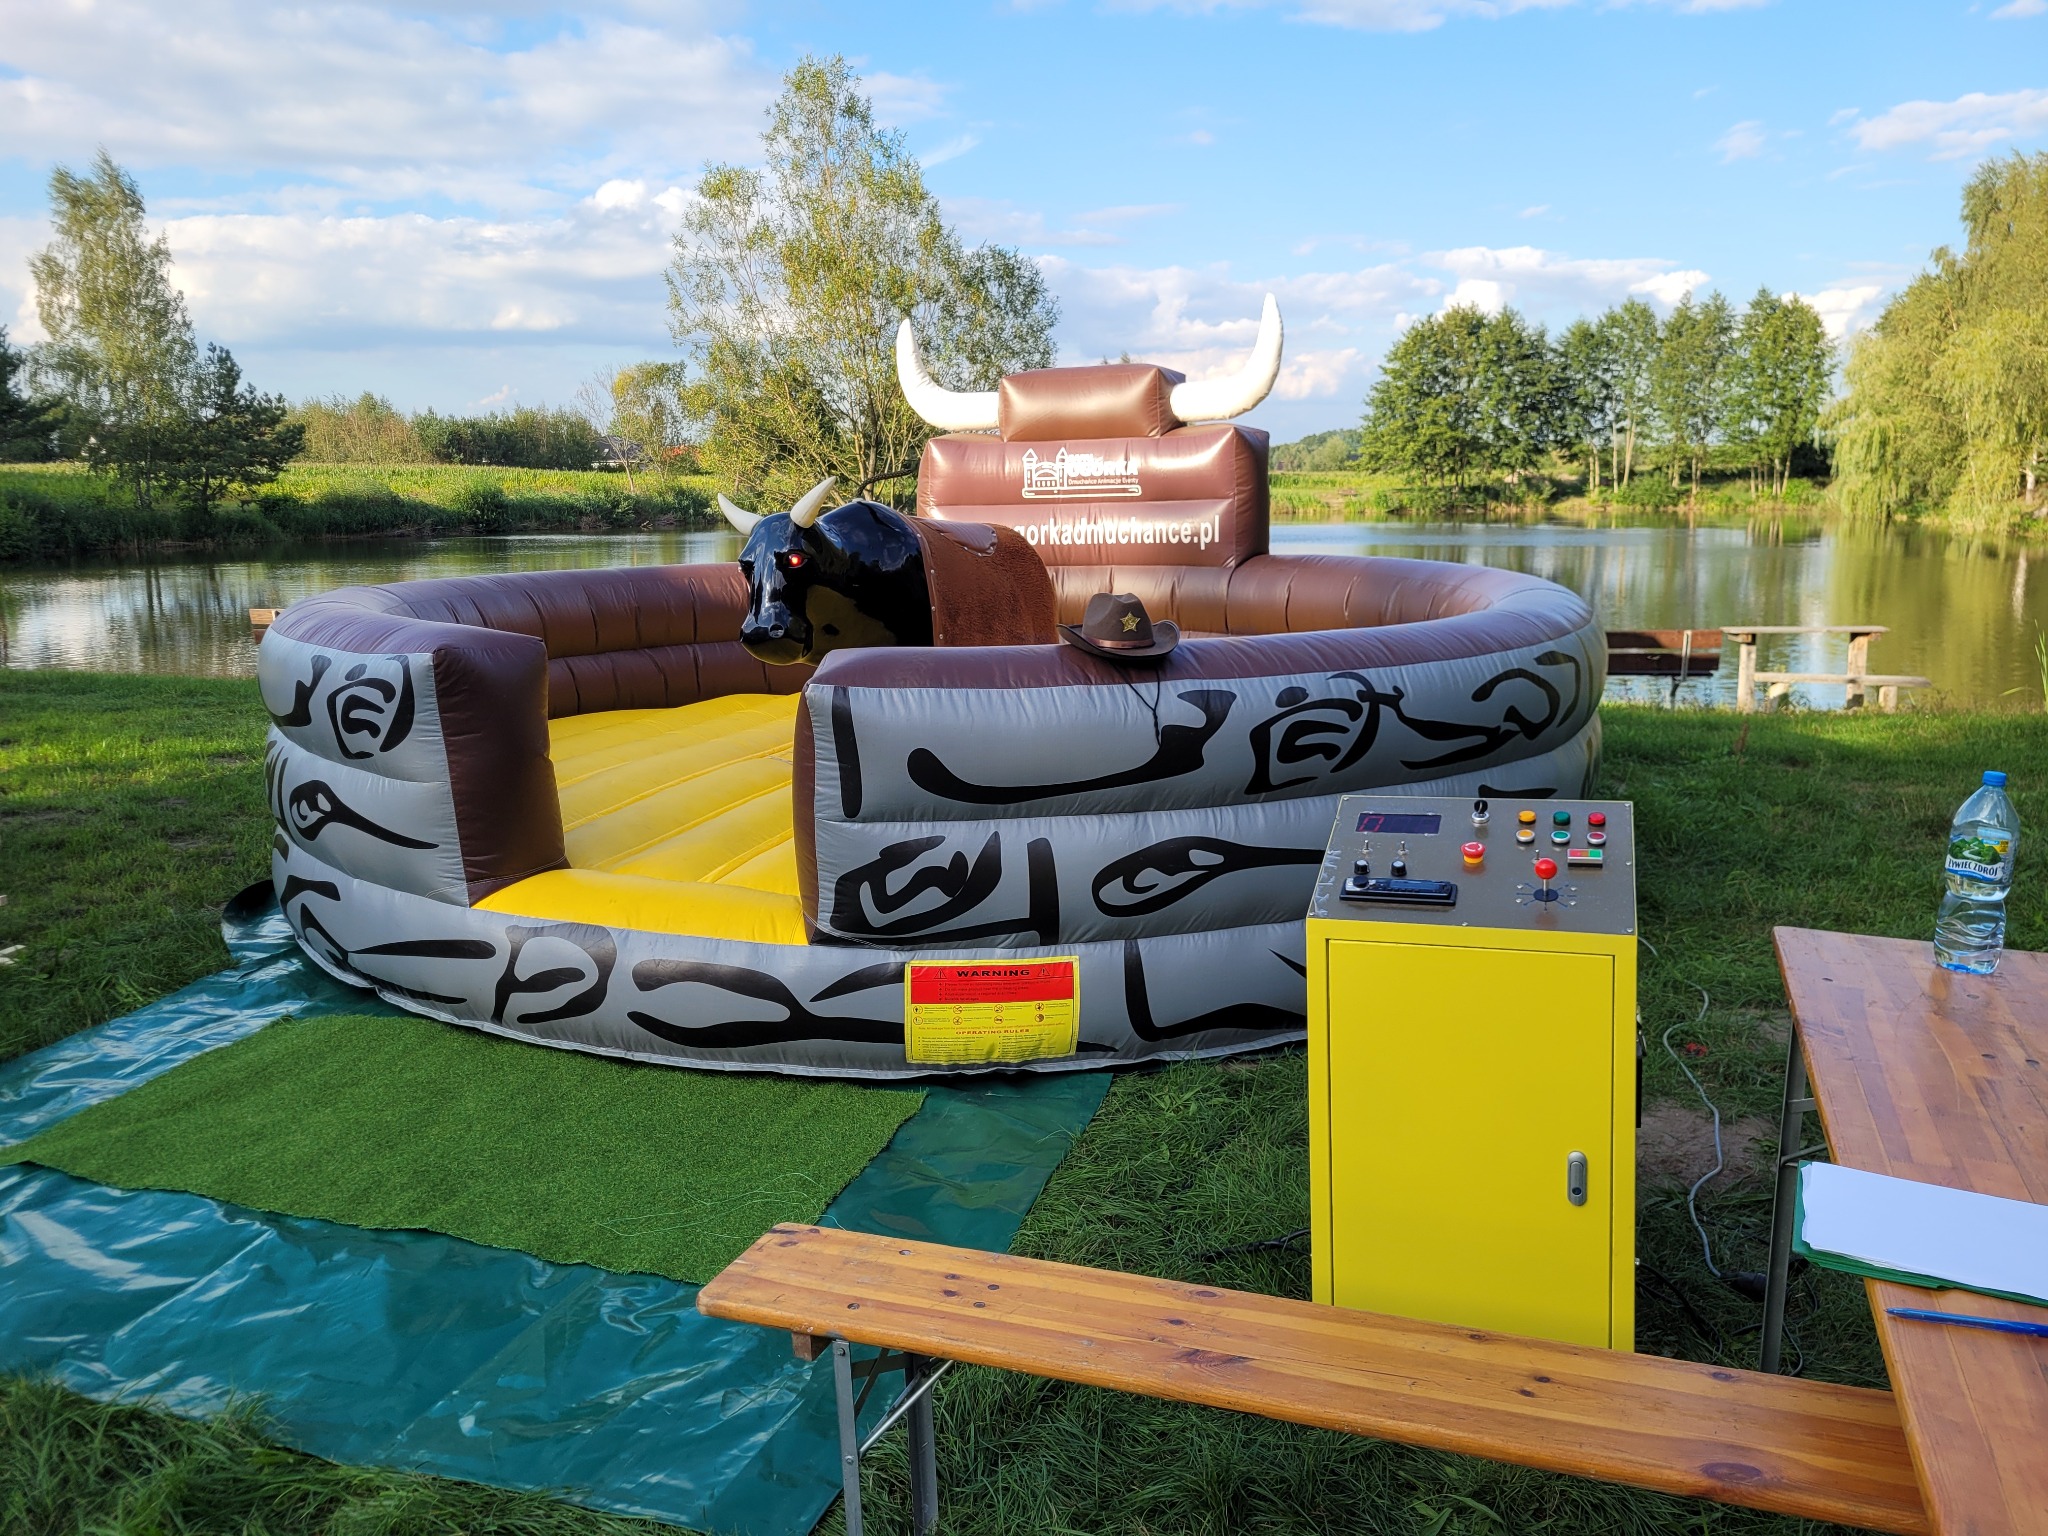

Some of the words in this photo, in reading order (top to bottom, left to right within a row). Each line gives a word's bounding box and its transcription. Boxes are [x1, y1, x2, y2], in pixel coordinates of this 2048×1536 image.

[1098, 477, 1121, 486] Animacje
[1122, 475, 1139, 485] Eventy
[1974, 862, 1998, 877] ZDRÓJ
[956, 969, 1030, 977] WARNING
